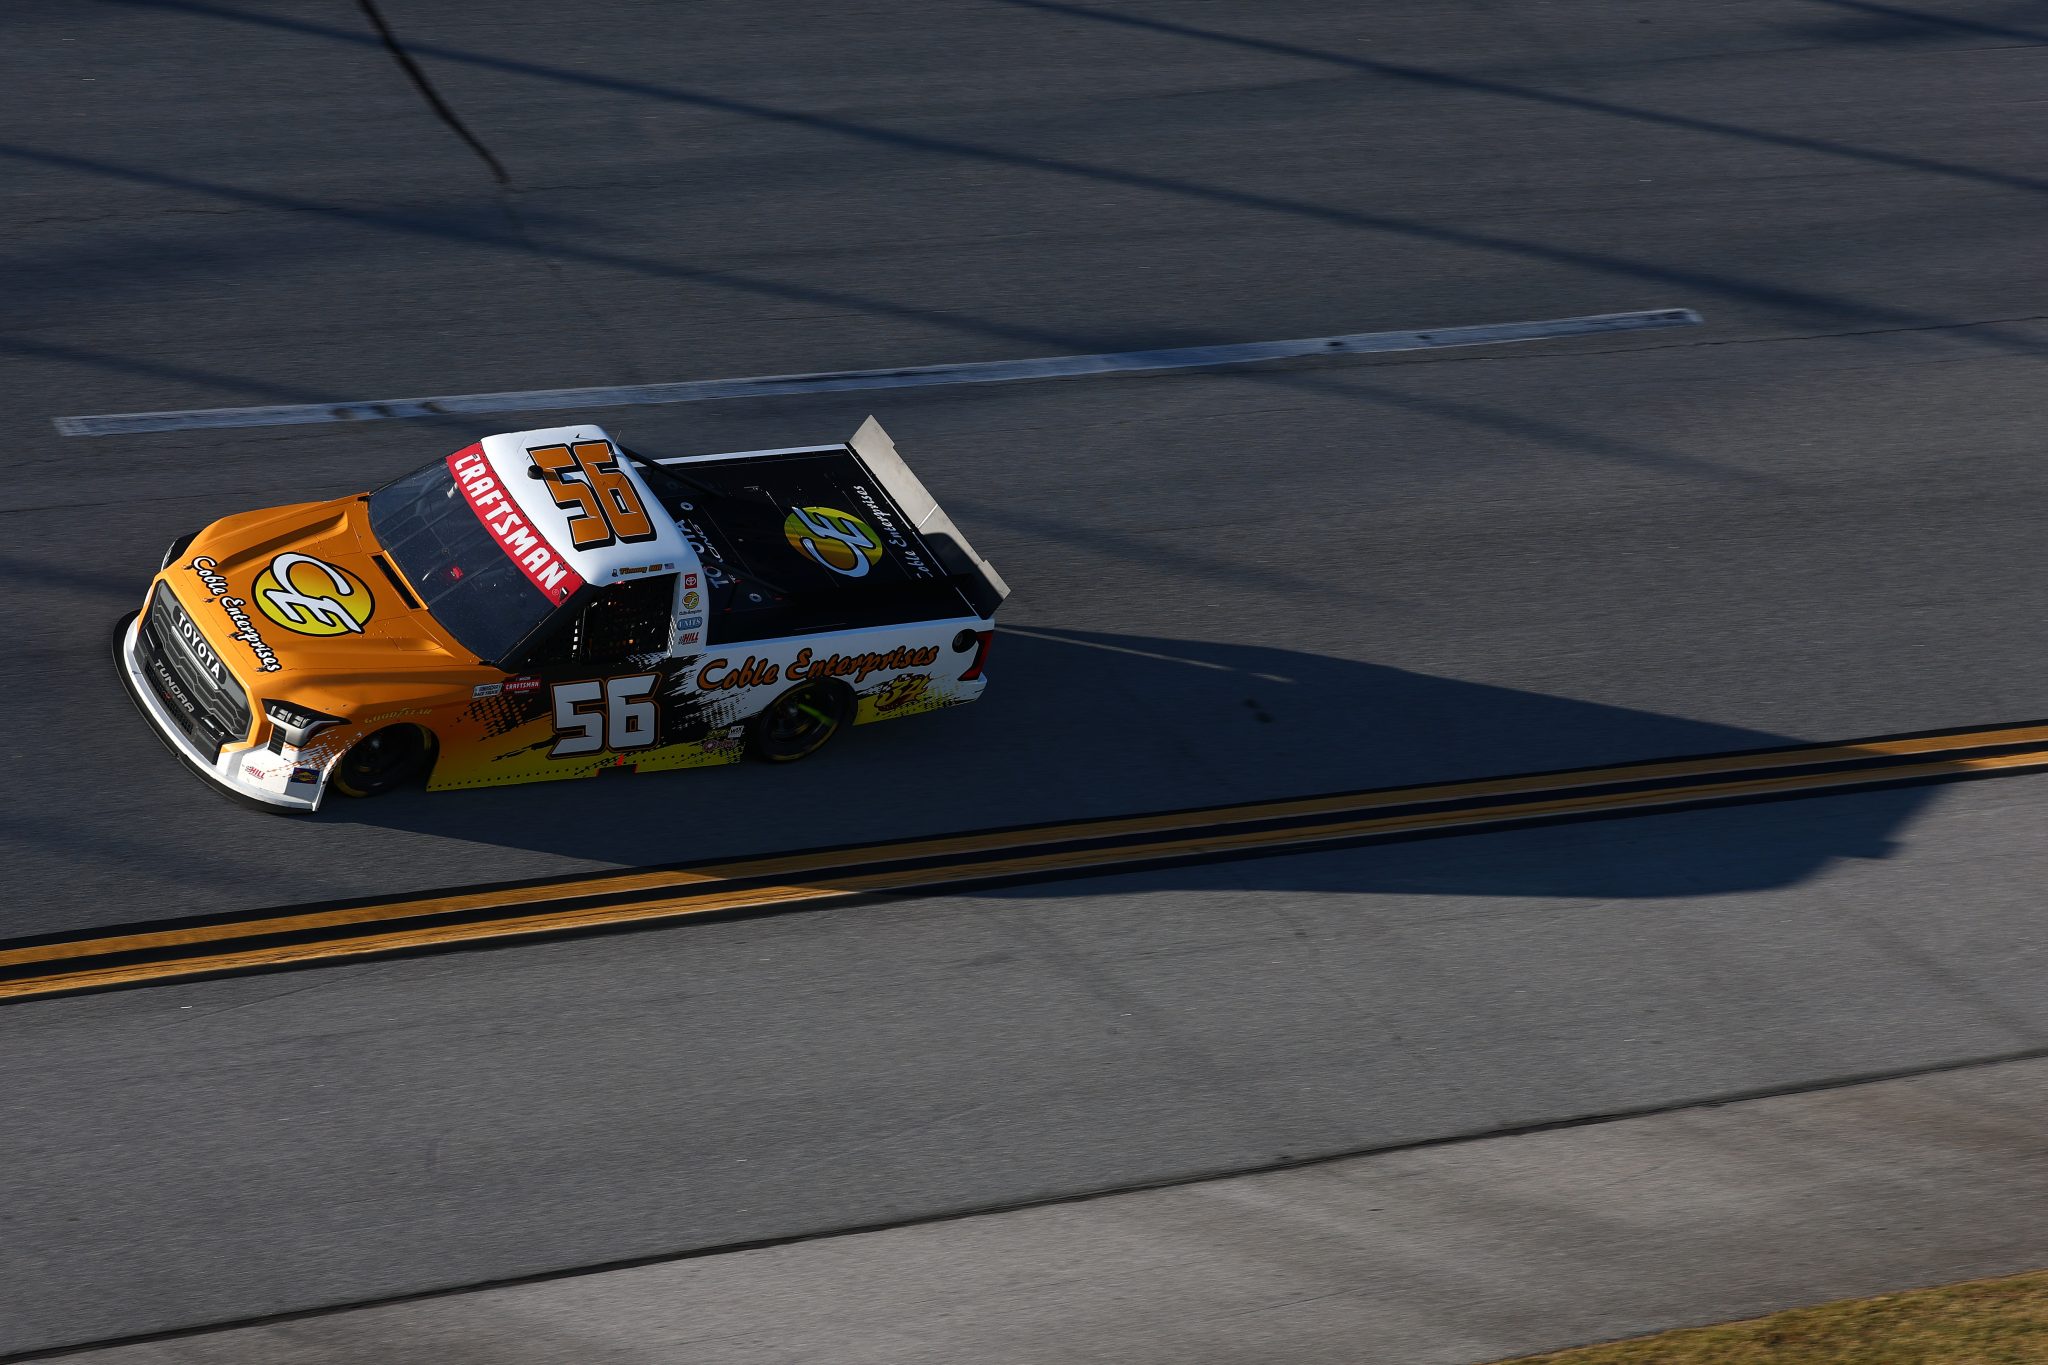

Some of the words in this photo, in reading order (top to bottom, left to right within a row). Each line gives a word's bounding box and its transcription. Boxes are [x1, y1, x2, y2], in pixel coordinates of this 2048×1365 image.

[454, 453, 568, 591] CRAFTSMAN
[526, 440, 657, 551] 56
[852, 484, 906, 546] Enterprises
[674, 518, 729, 588] TOOTA
[177, 611, 221, 680] TOYOTA
[192, 556, 226, 598] Coble
[219, 595, 282, 673] Enterprises
[154, 658, 195, 713] TUNDRA
[696, 656, 779, 690] Coble
[787, 645, 940, 684] Enterprises
[547, 673, 661, 758] 56
